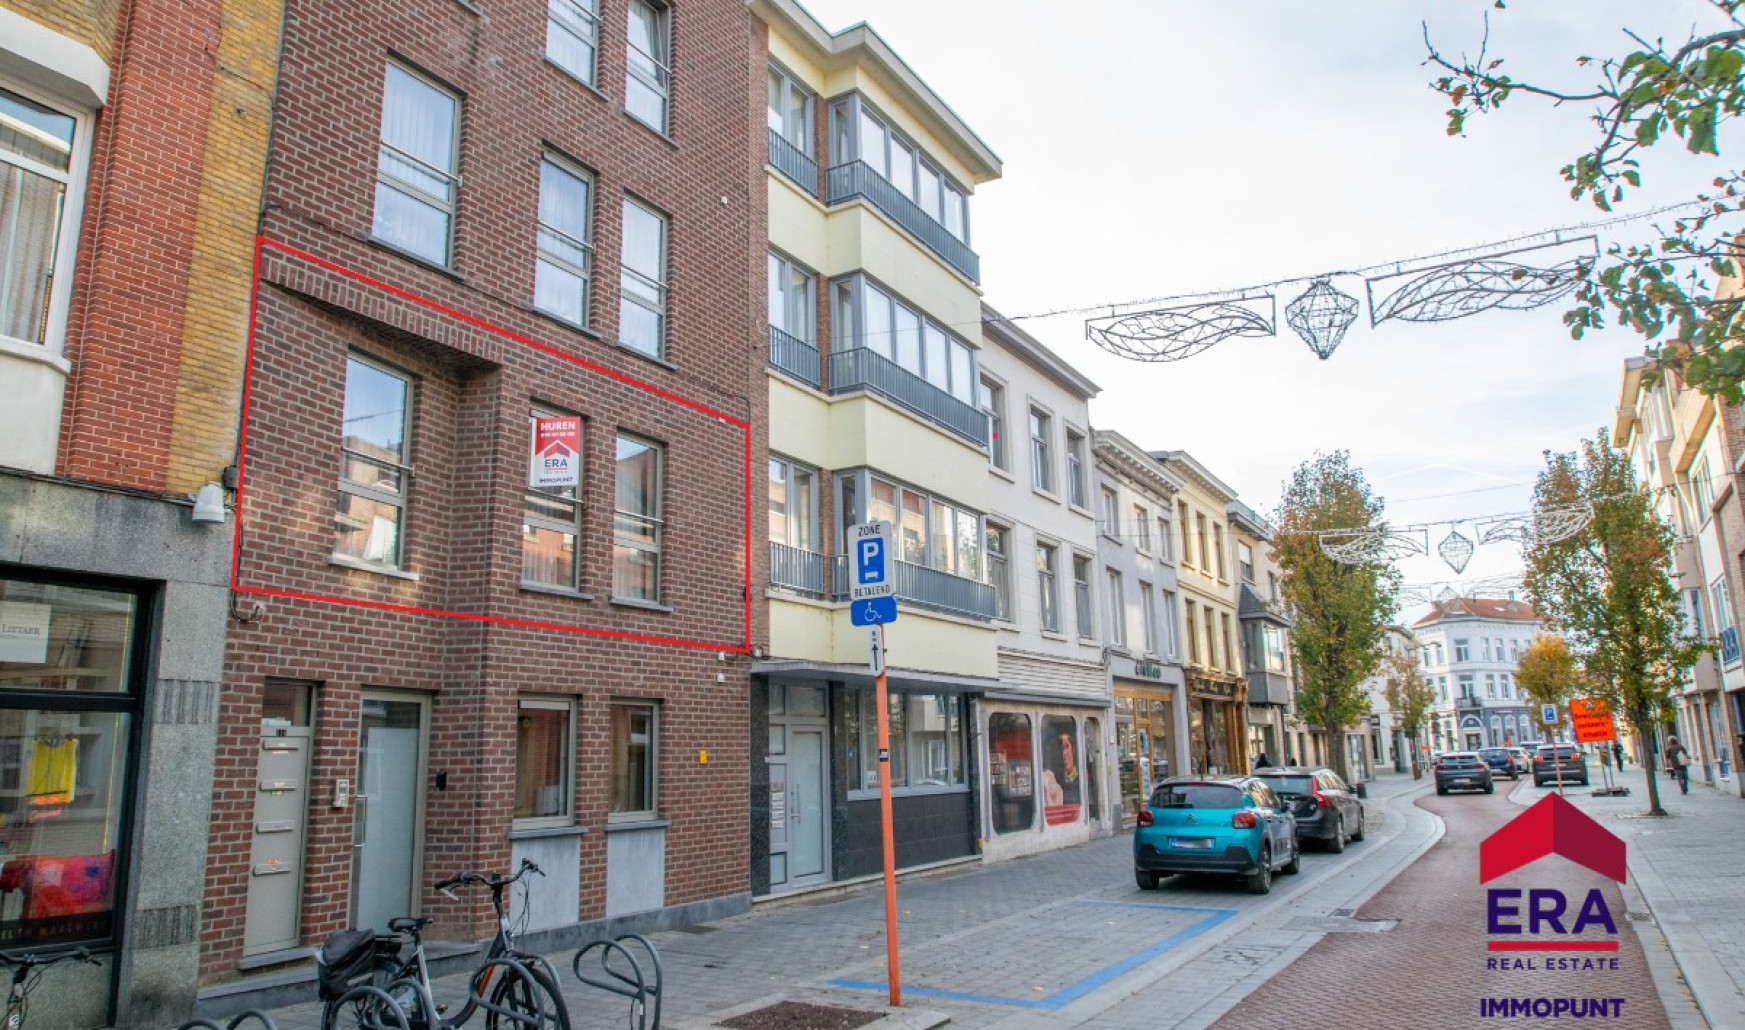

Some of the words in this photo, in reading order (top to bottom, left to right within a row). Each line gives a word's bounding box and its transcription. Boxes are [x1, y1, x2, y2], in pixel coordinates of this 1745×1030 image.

[541, 422, 576, 431] HUREN
[545, 459, 568, 467] ERA
[858, 525, 881, 536] ZONE
[864, 542, 879, 566] P
[855, 585, 891, 597] BETALEND
